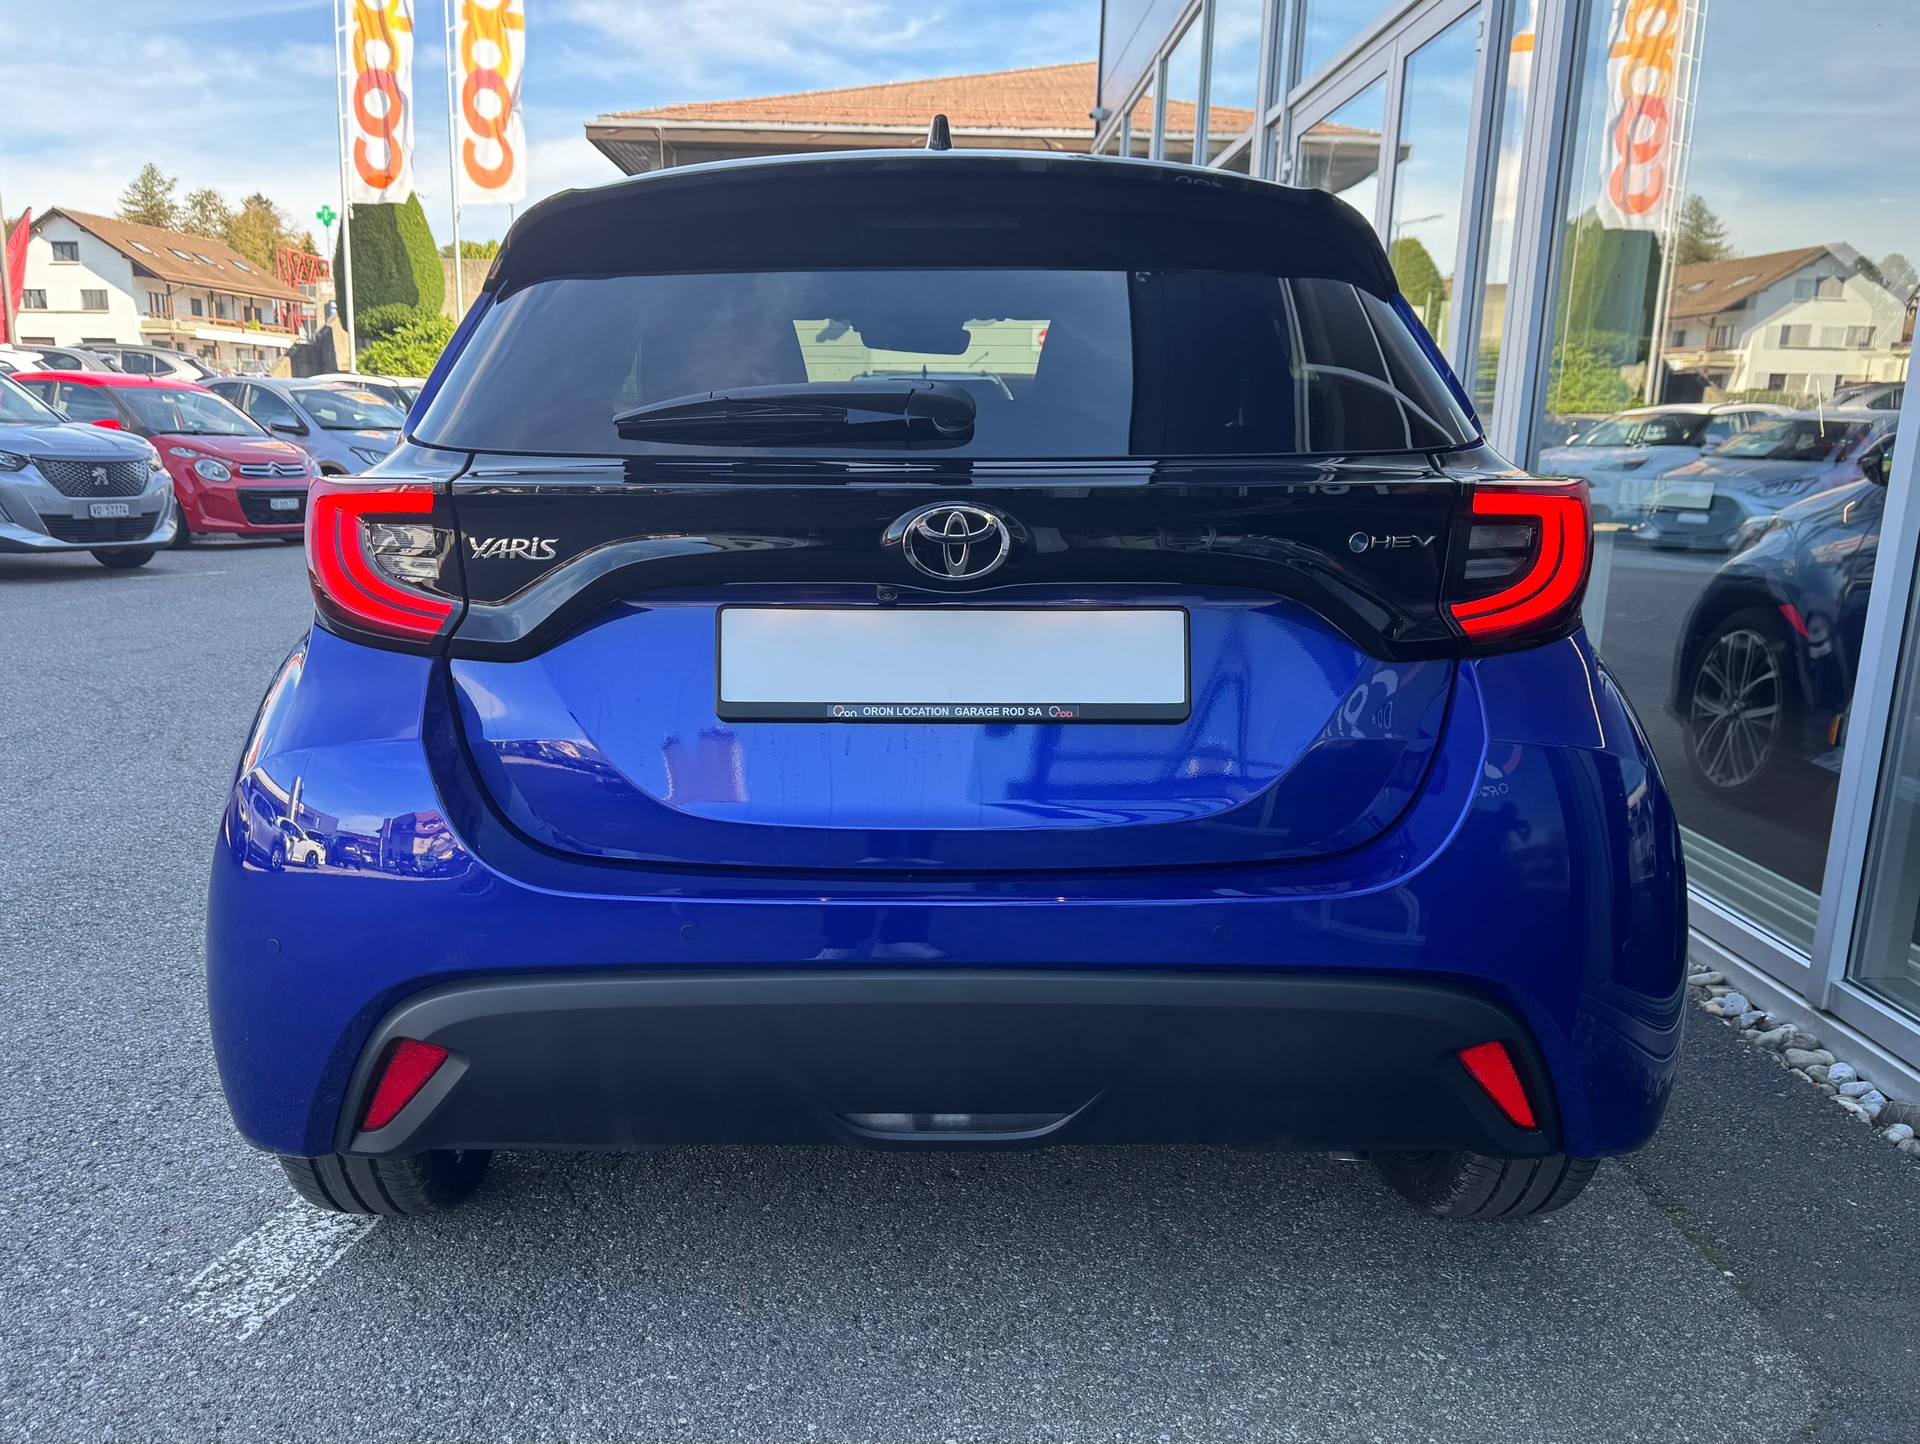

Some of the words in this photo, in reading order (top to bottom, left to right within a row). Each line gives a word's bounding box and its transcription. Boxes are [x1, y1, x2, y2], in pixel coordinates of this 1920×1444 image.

[1370, 534, 1437, 549] HEV
[863, 706, 894, 716] ORON
[896, 706, 949, 716] LOCATION
[954, 707, 1000, 717] GARAGE
[1002, 707, 1025, 717] ROD
[1027, 707, 1042, 717] SA
